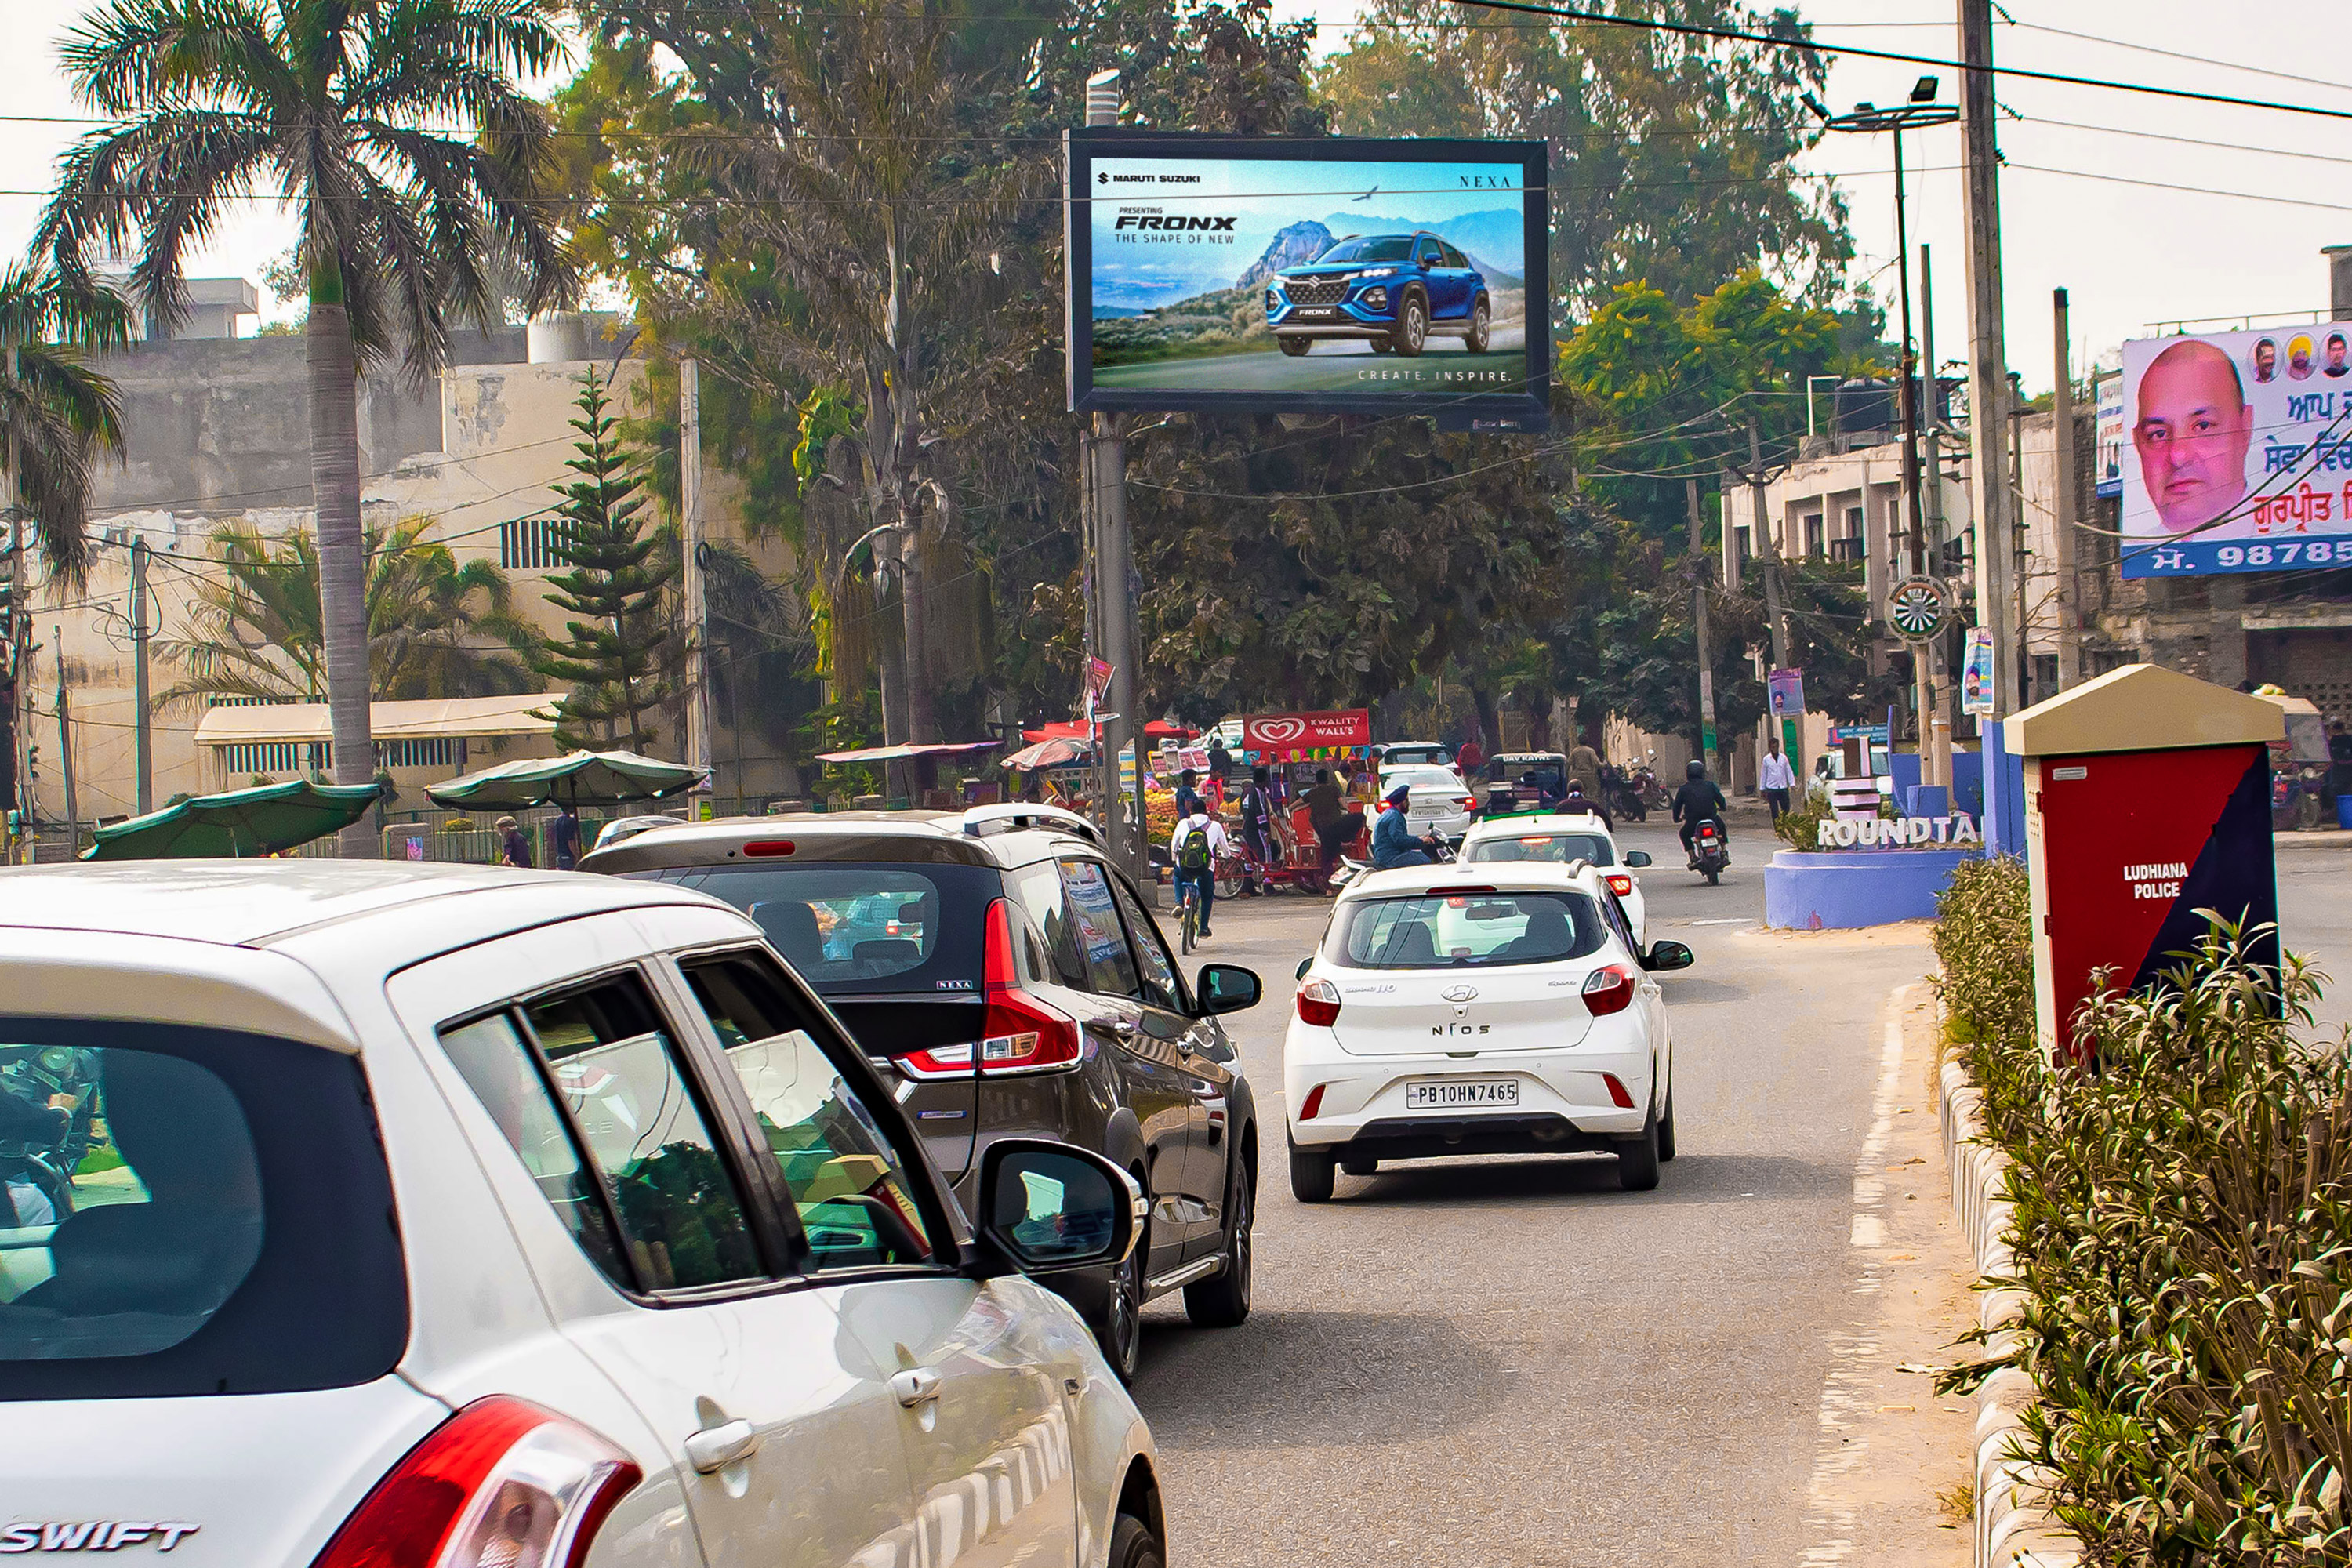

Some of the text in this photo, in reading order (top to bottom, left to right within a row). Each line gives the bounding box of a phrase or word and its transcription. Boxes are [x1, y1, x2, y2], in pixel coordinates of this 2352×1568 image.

[1460, 176, 1510, 187] NEXA
[1115, 216, 1238, 230] FRONX
[1115, 234, 1235, 244] THE SHAPE OF NEW
[1358, 370, 1512, 382] CREATE. INSPIRE.
[2217, 541, 2352, 566] 98785
[1311, 717, 1359, 726] KWALITY
[1316, 726, 1354, 735] WALL'S
[1818, 816, 1984, 847] ROUNDTA
[2123, 862, 2189, 881] LUDHIANA
[2134, 882, 2180, 899] POLICE
[1419, 1084, 1515, 1103] PB10HN7465
[0, 1520, 201, 1553] SWIFT
